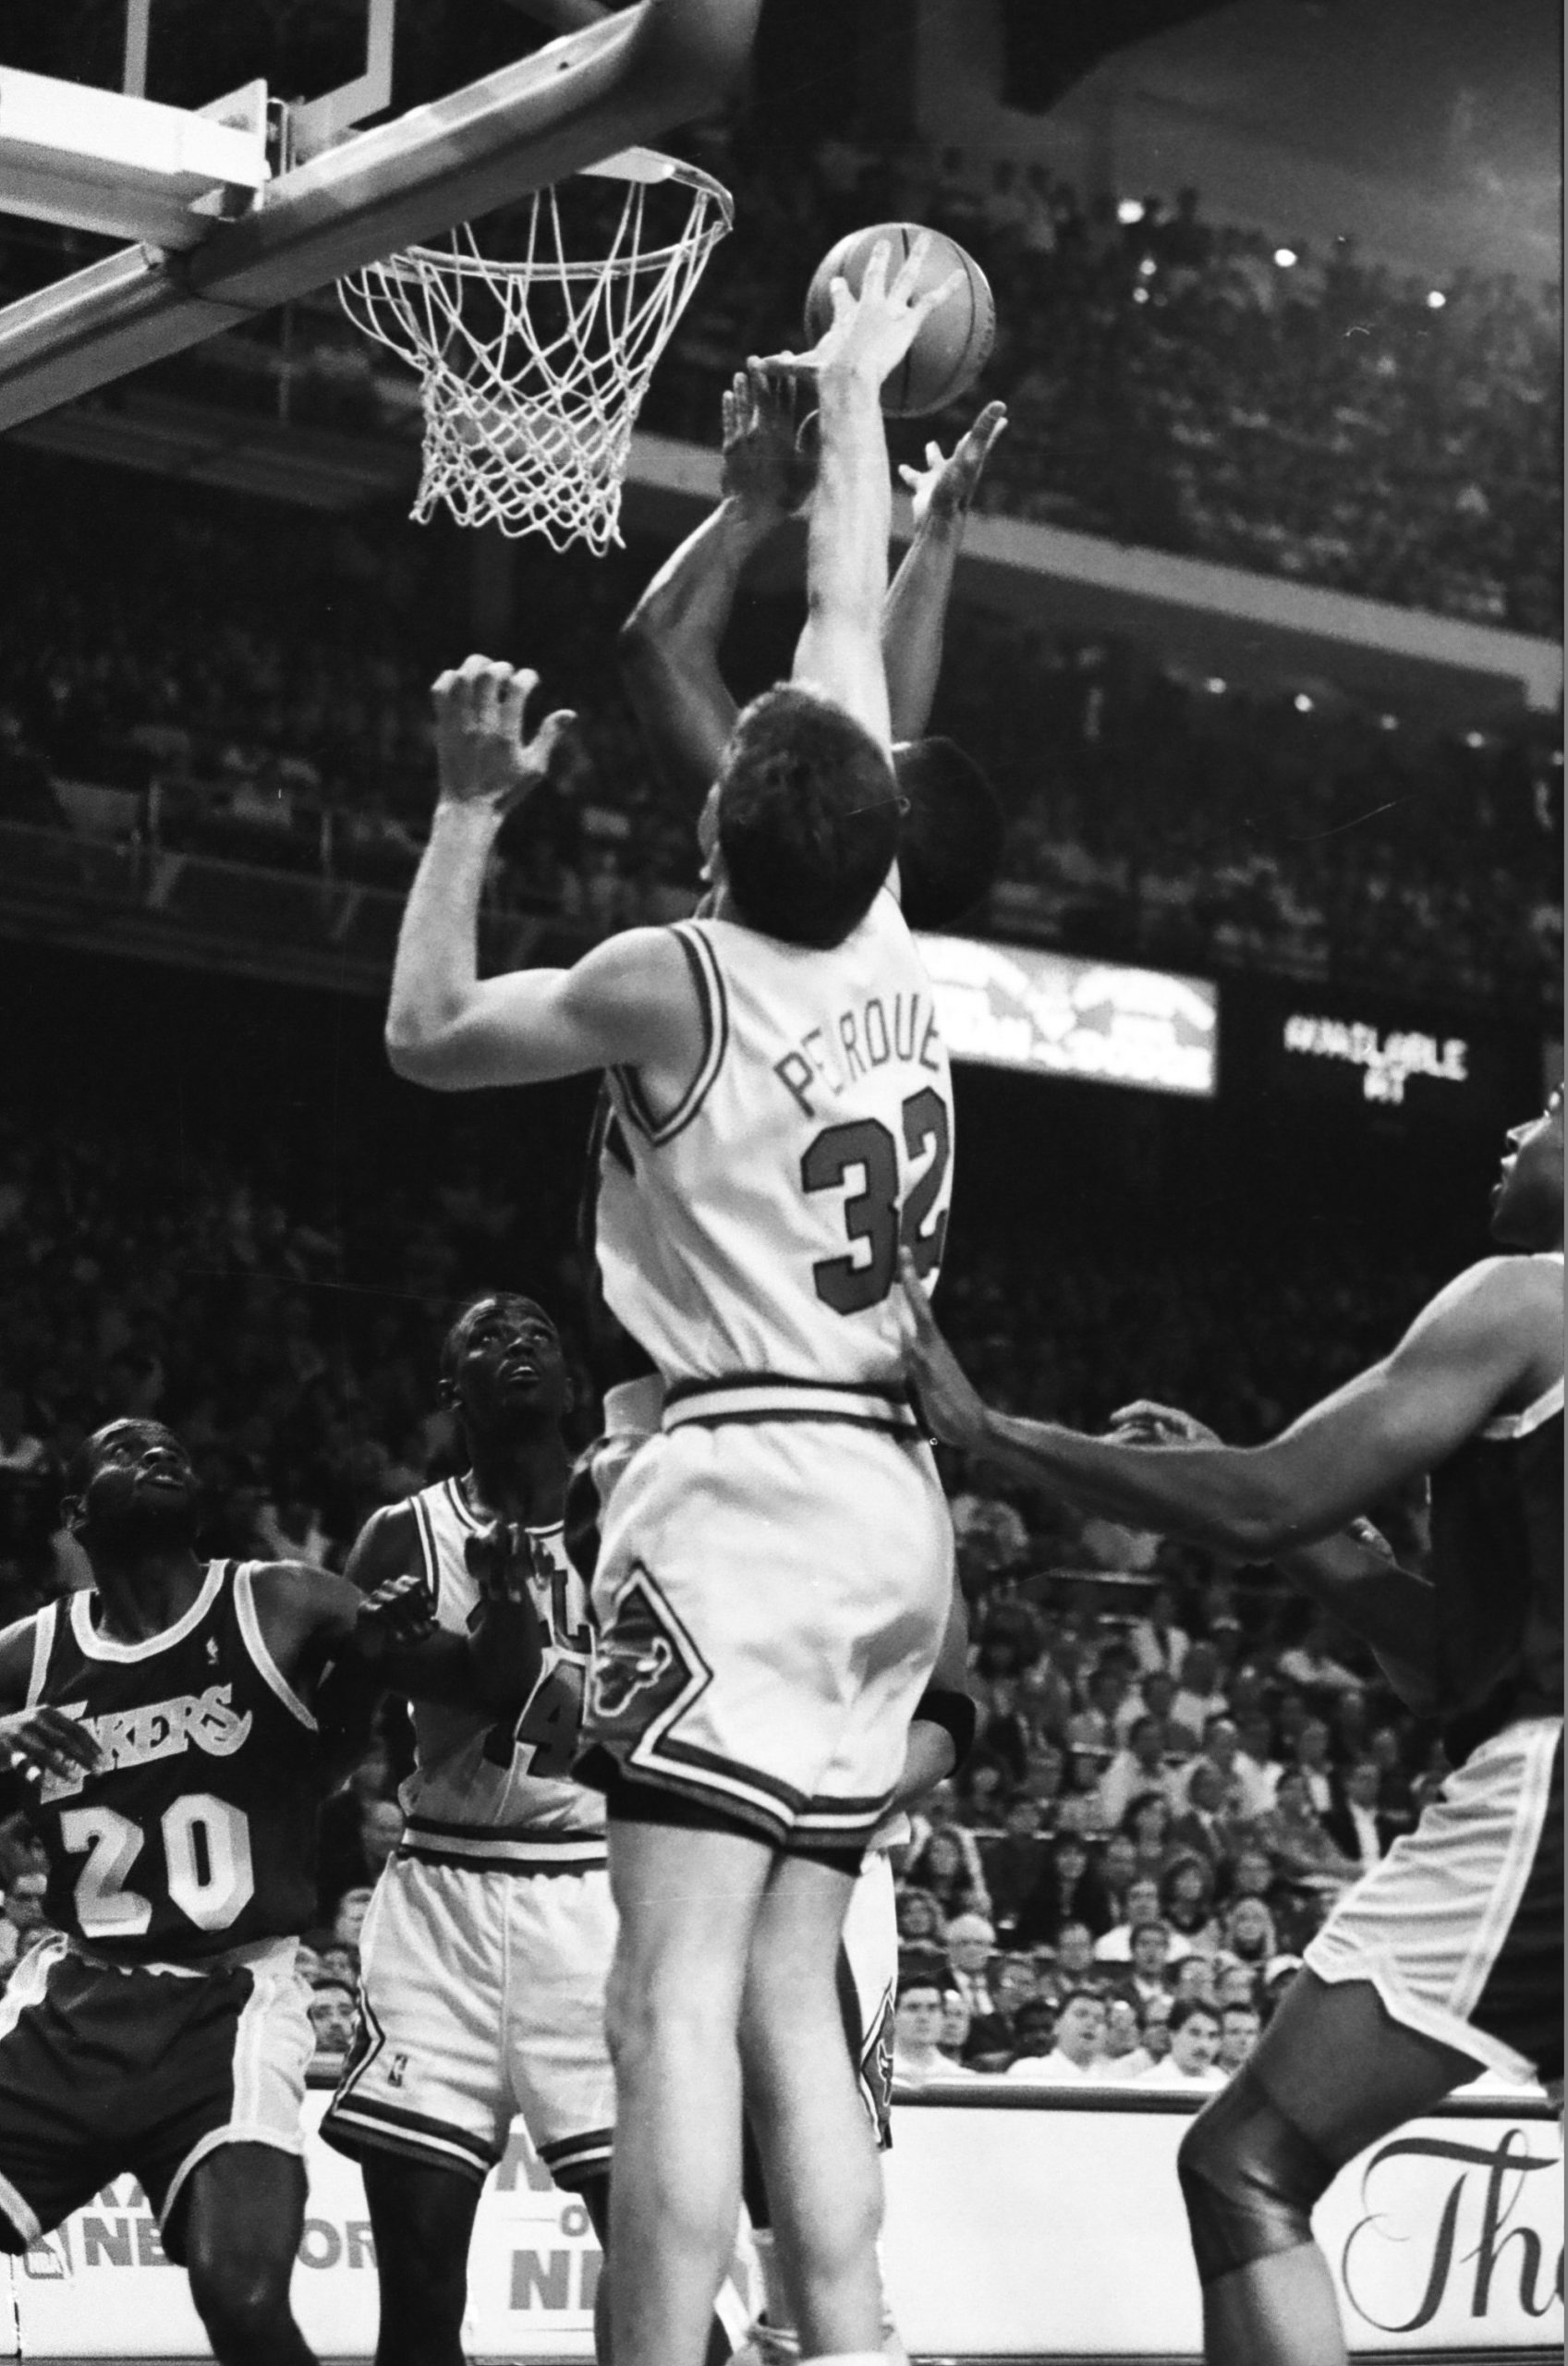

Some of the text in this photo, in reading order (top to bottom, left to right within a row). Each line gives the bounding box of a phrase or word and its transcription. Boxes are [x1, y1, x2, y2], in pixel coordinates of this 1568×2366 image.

[772, 992, 939, 1118] PERDUE
[799, 1085, 951, 1317] 32
[59, 1793, 255, 1938] 20
[1343, 2128, 1564, 2333] Th
